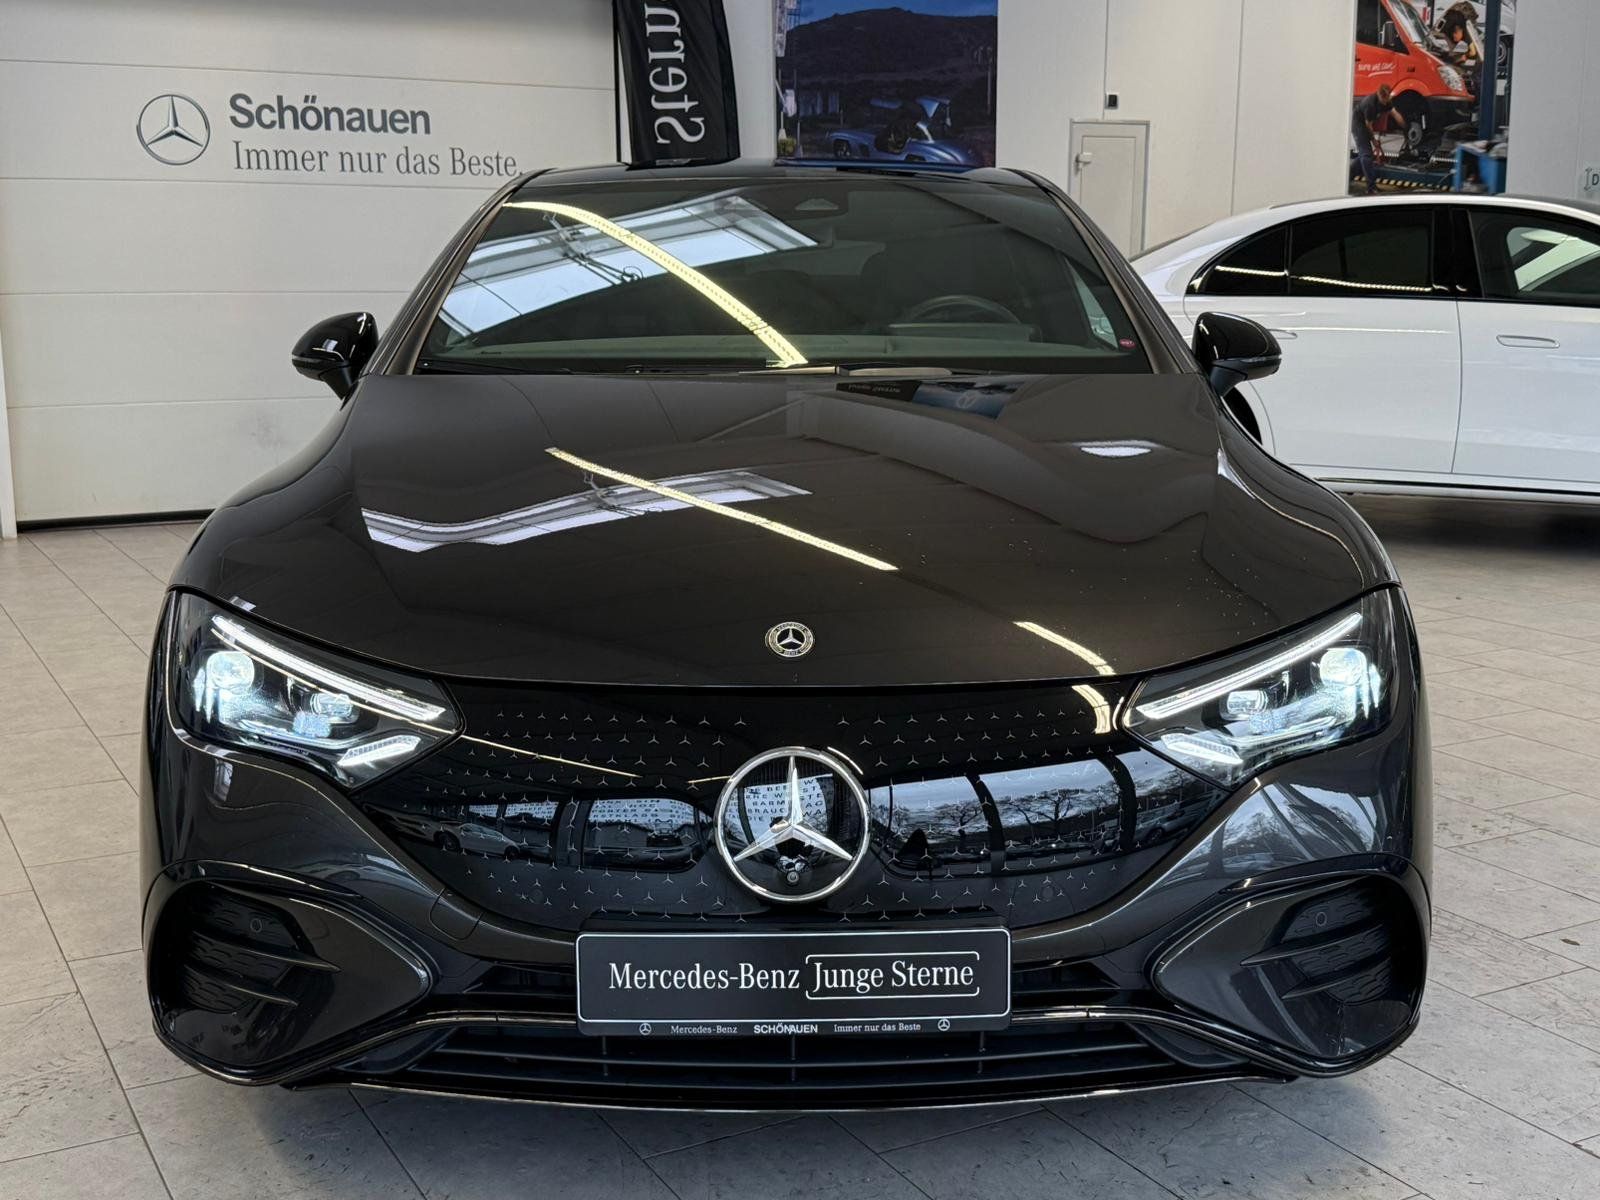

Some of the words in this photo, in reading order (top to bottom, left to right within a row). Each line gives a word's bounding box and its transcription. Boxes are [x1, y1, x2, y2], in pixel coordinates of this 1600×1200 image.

[229, 93, 431, 135] Schönauen
[232, 140, 329, 172] Immer
[338, 150, 387, 174] nur
[396, 146, 440, 175] das
[608, 962, 800, 990] Mercedes-Benz
[812, 961, 884, 994] Junge
[891, 960, 974, 987] Sterne
[670, 1025, 737, 1034] Mercedes-Benz
[834, 1024, 862, 1033] Immer
[882, 1023, 897, 1032] das
[898, 1022, 922, 1032] Beste
